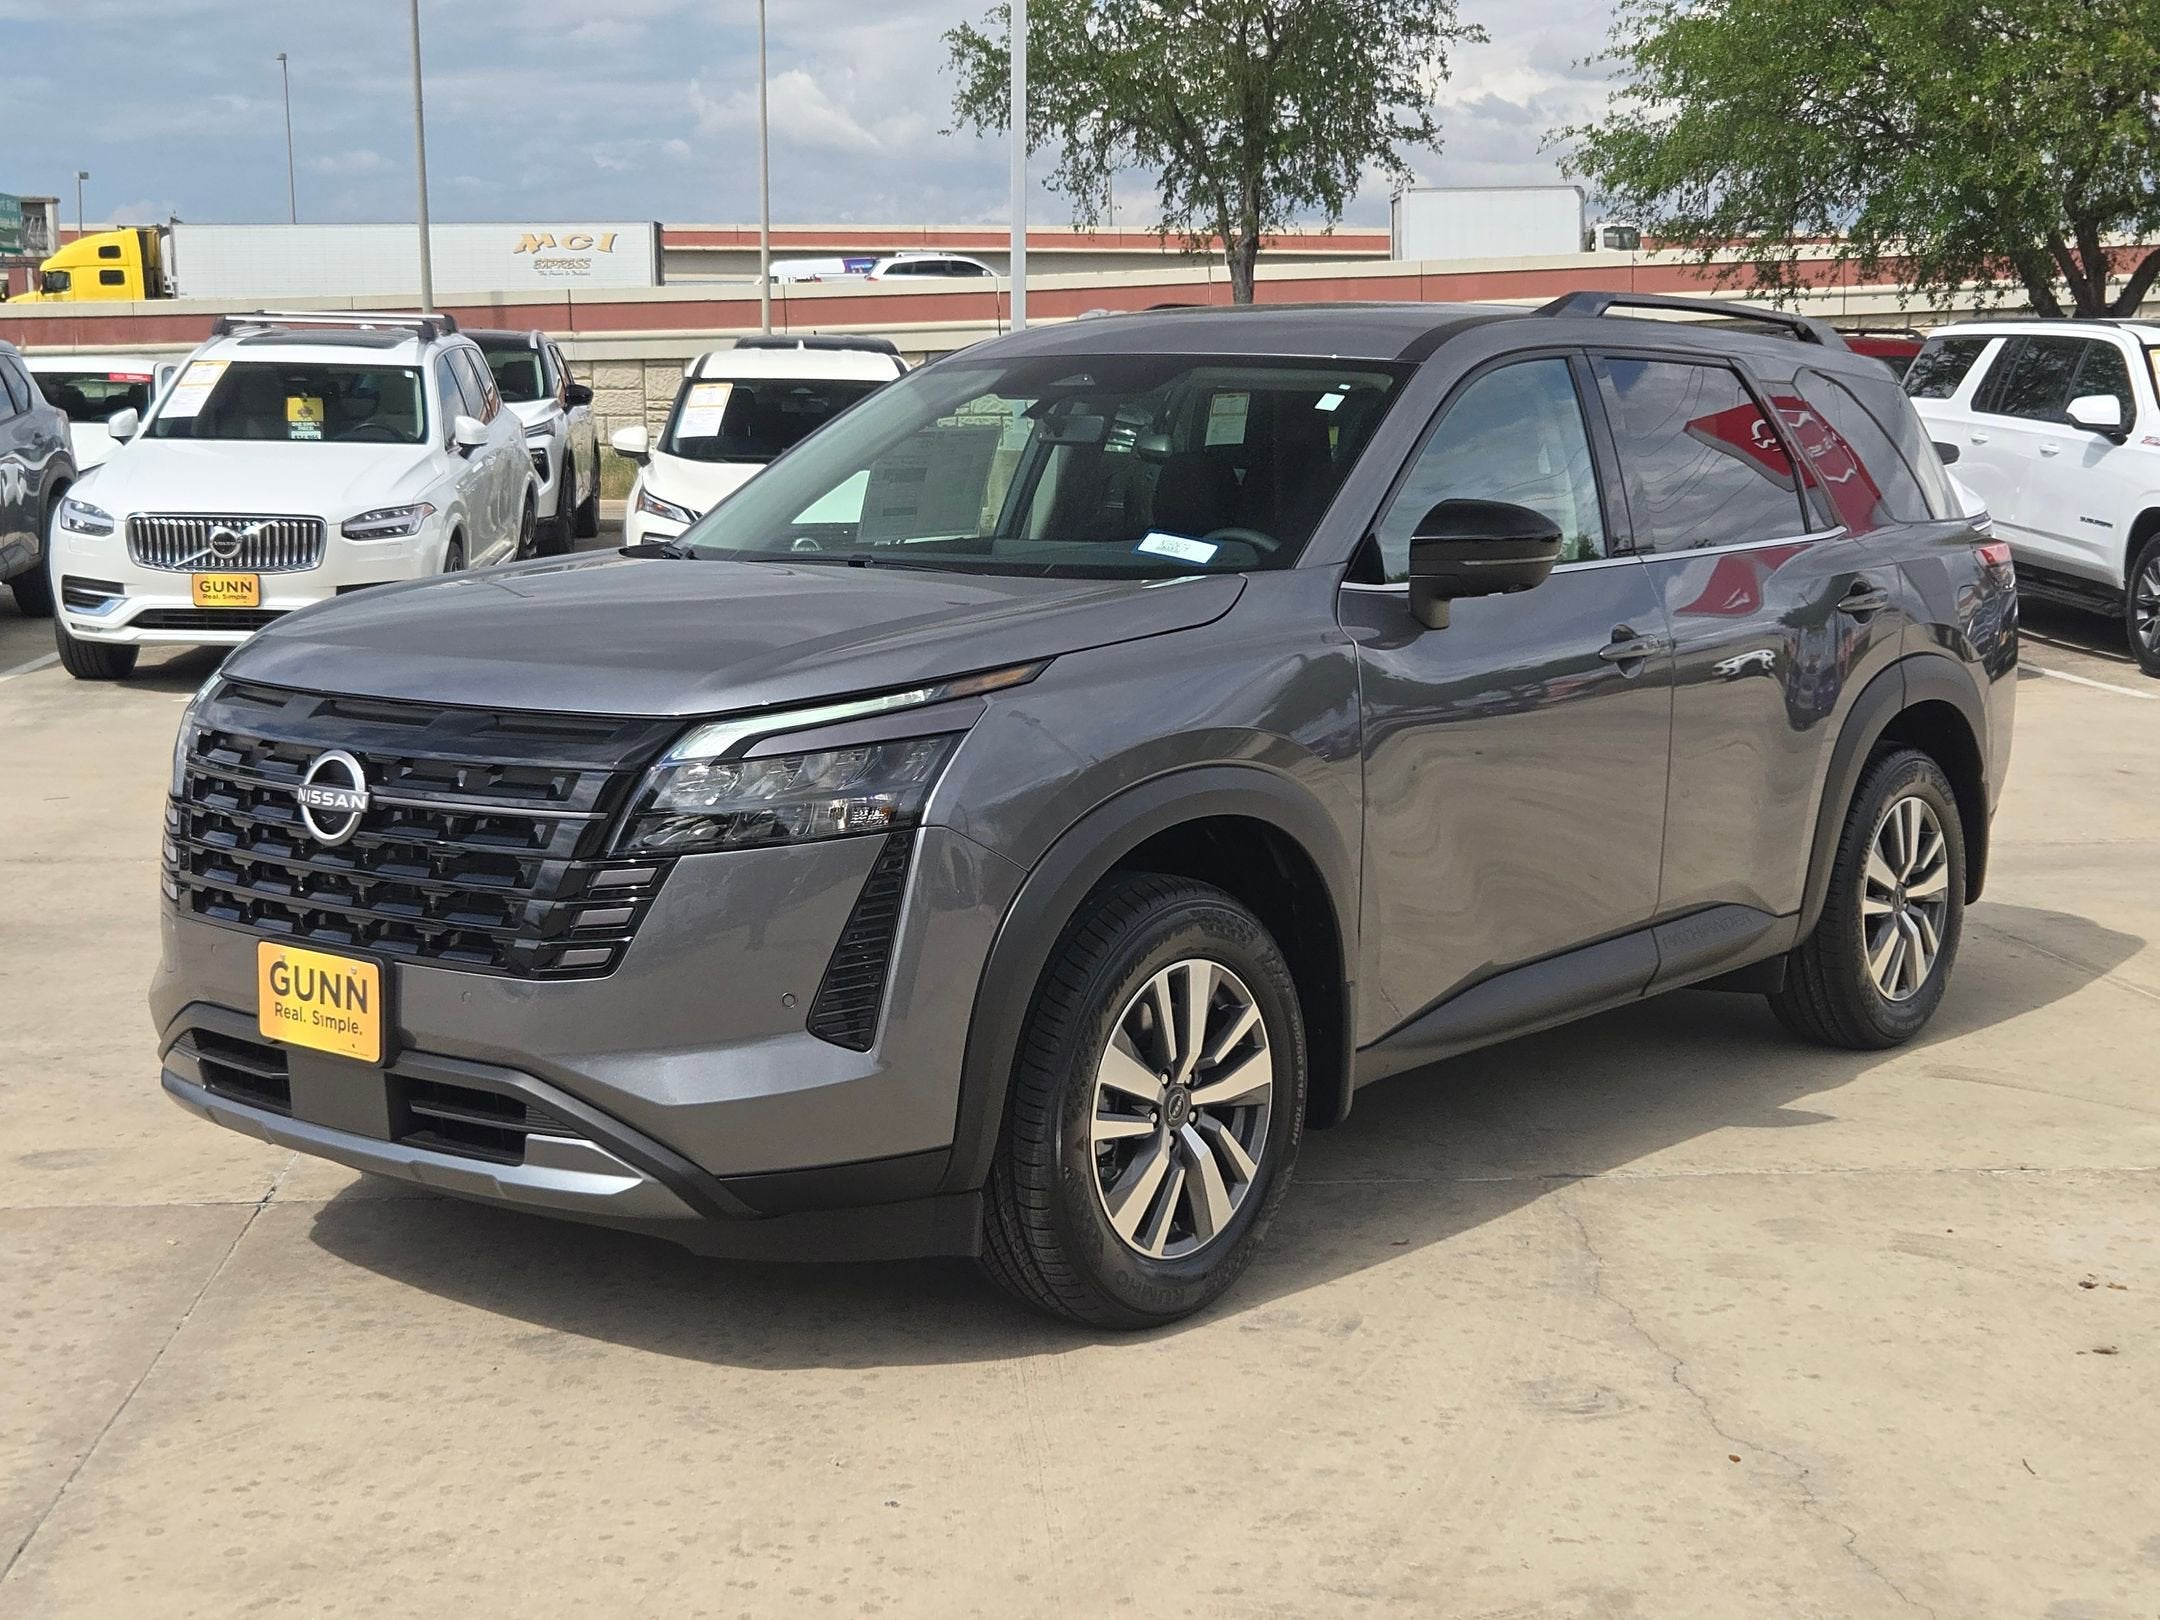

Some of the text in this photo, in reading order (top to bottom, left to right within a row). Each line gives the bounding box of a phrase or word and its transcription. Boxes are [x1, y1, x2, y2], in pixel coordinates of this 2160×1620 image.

[513, 233, 618, 254] MCI
[534, 258, 592, 270] EXPRESS
[200, 580, 252, 593] GUNN
[297, 787, 366, 810] NISSAN
[270, 960, 367, 1014] GUNN
[274, 1002, 363, 1036] Real. Simple.
